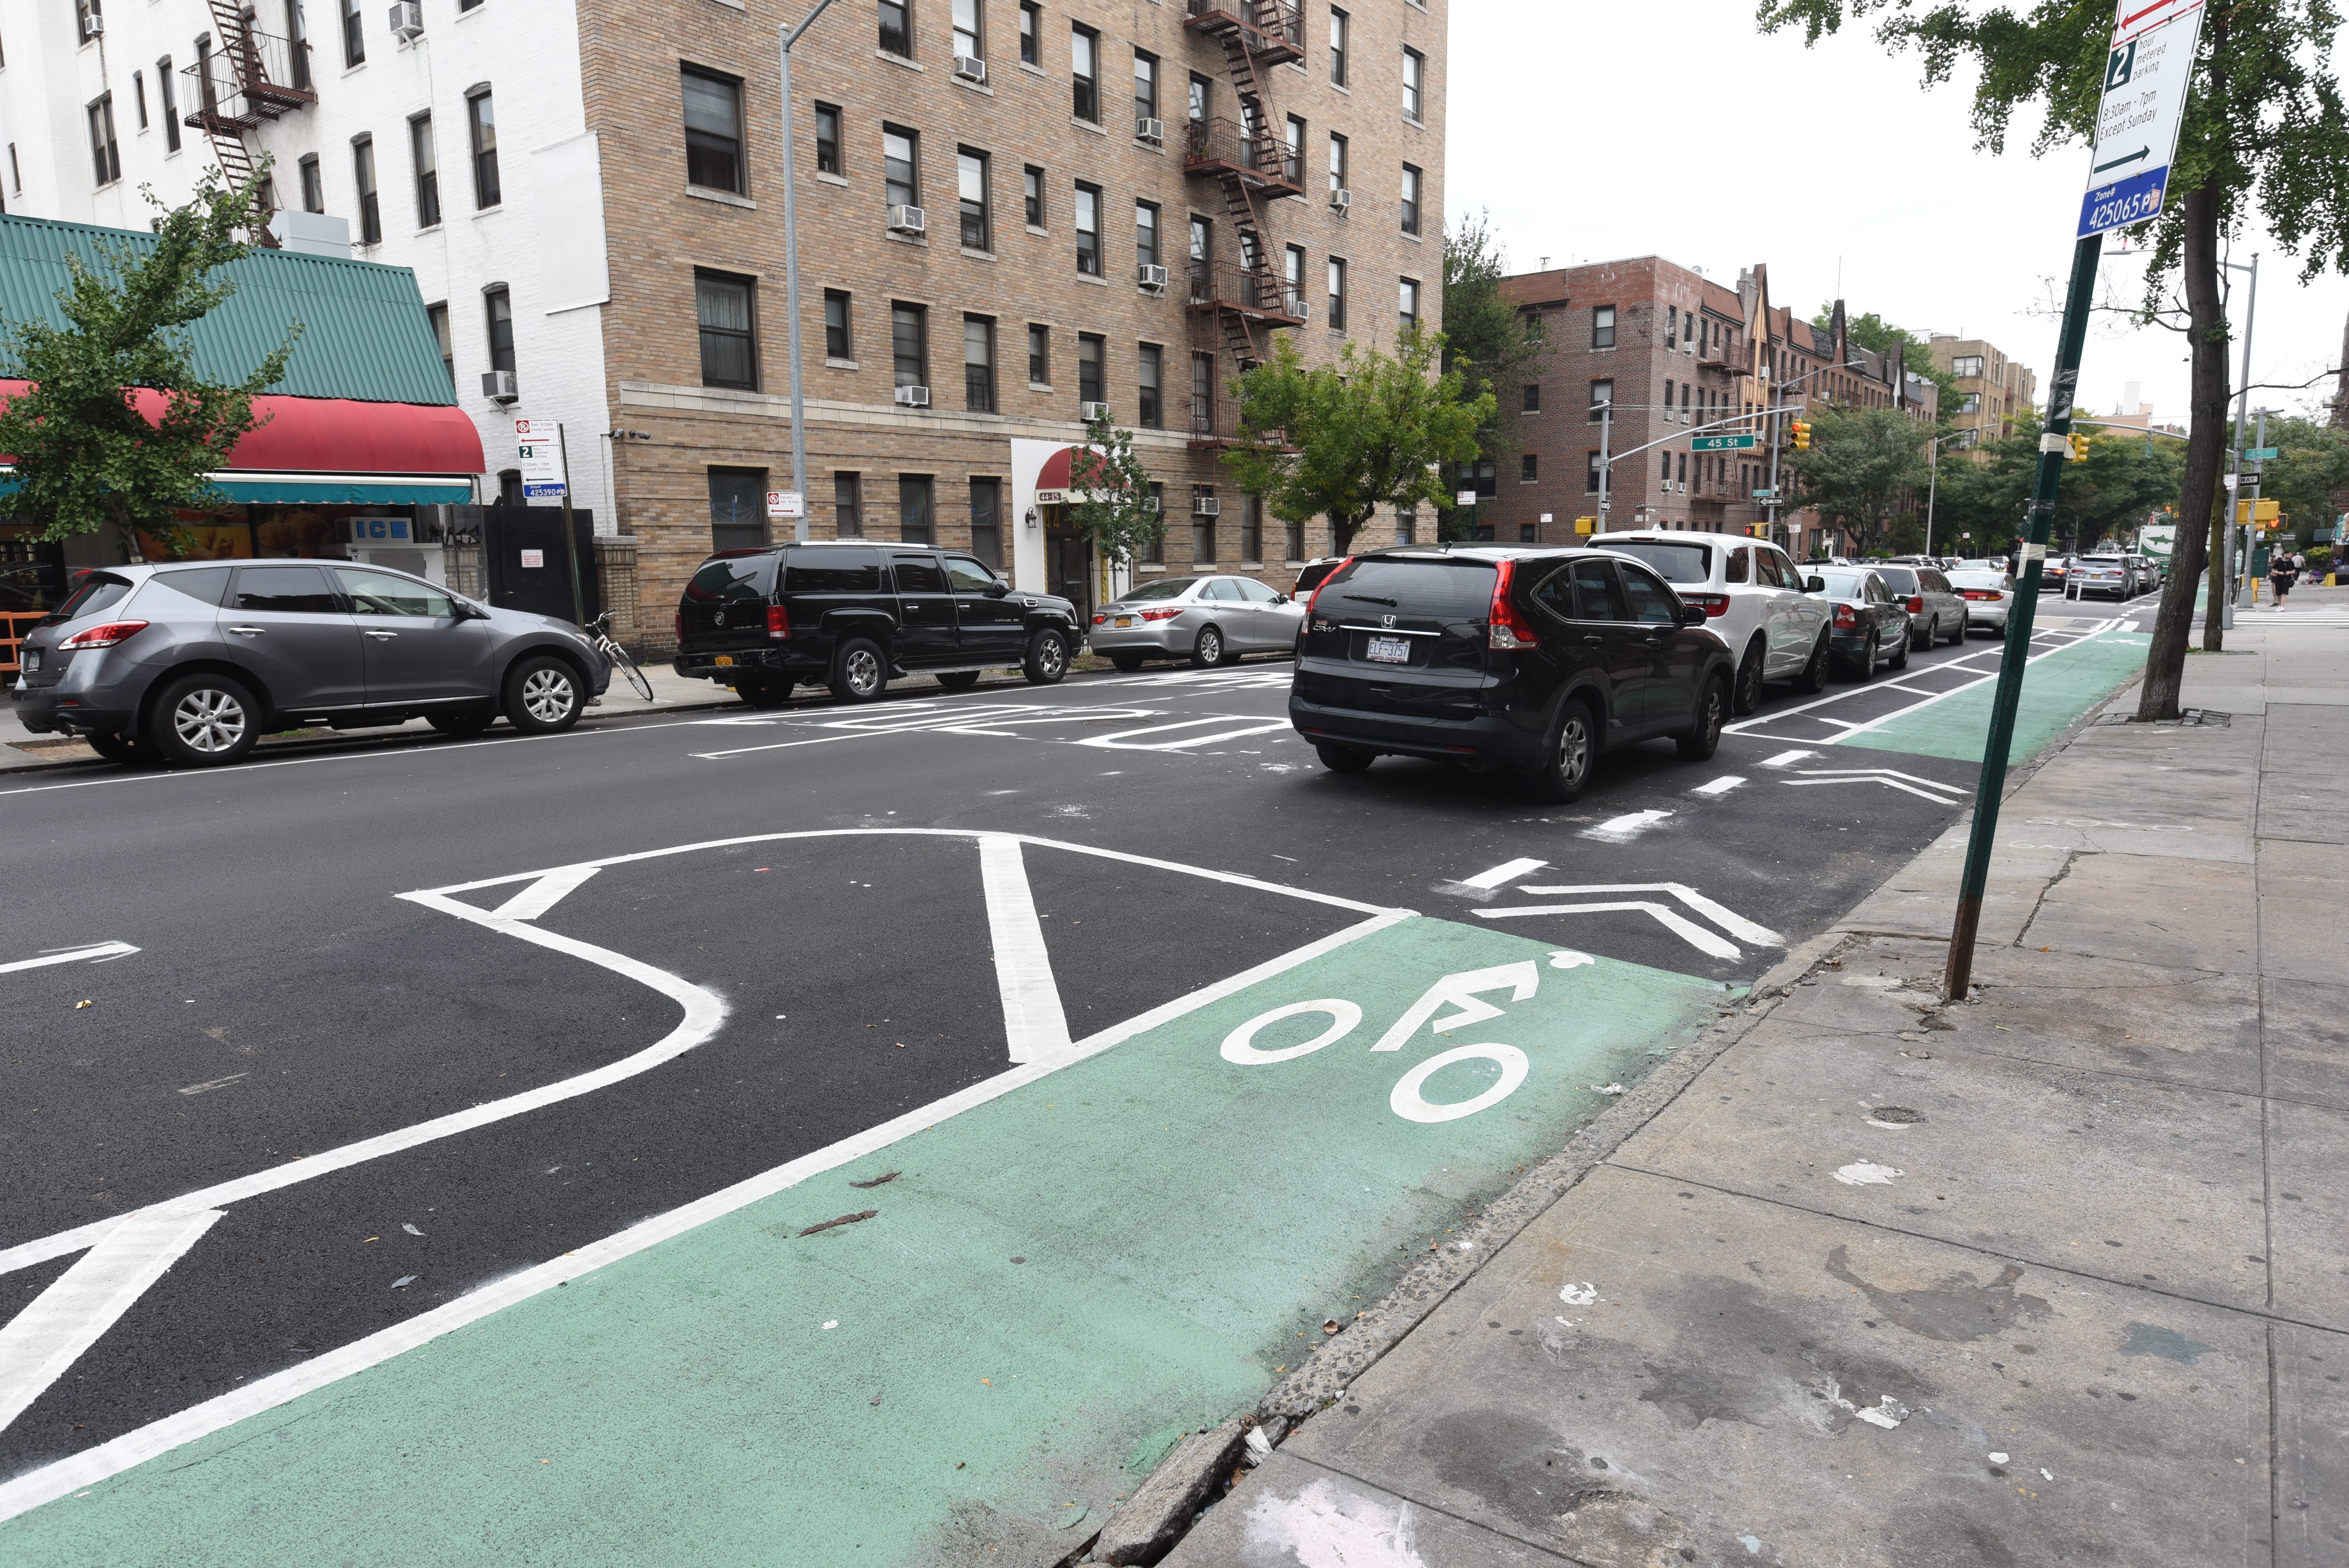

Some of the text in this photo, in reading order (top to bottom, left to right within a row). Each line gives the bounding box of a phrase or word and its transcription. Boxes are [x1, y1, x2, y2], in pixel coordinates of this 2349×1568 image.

[2135, 41, 2167, 66] metered
[2138, 36, 2155, 51] hour
[2111, 45, 2129, 86] 2
[2133, 61, 2159, 83] parking
[2103, 101, 2131, 122] 8:30am
[2140, 90, 2156, 108] 7pm
[2100, 108, 2158, 141] Except Sunday
[2094, 186, 2116, 202] Zone#
[2089, 193, 2141, 229] 425065
[522, 447, 530, 457] 2
[1727, 438, 1738, 446] St
[356, 520, 408, 538] ICE
[1369, 642, 1408, 657] ELF-3757
